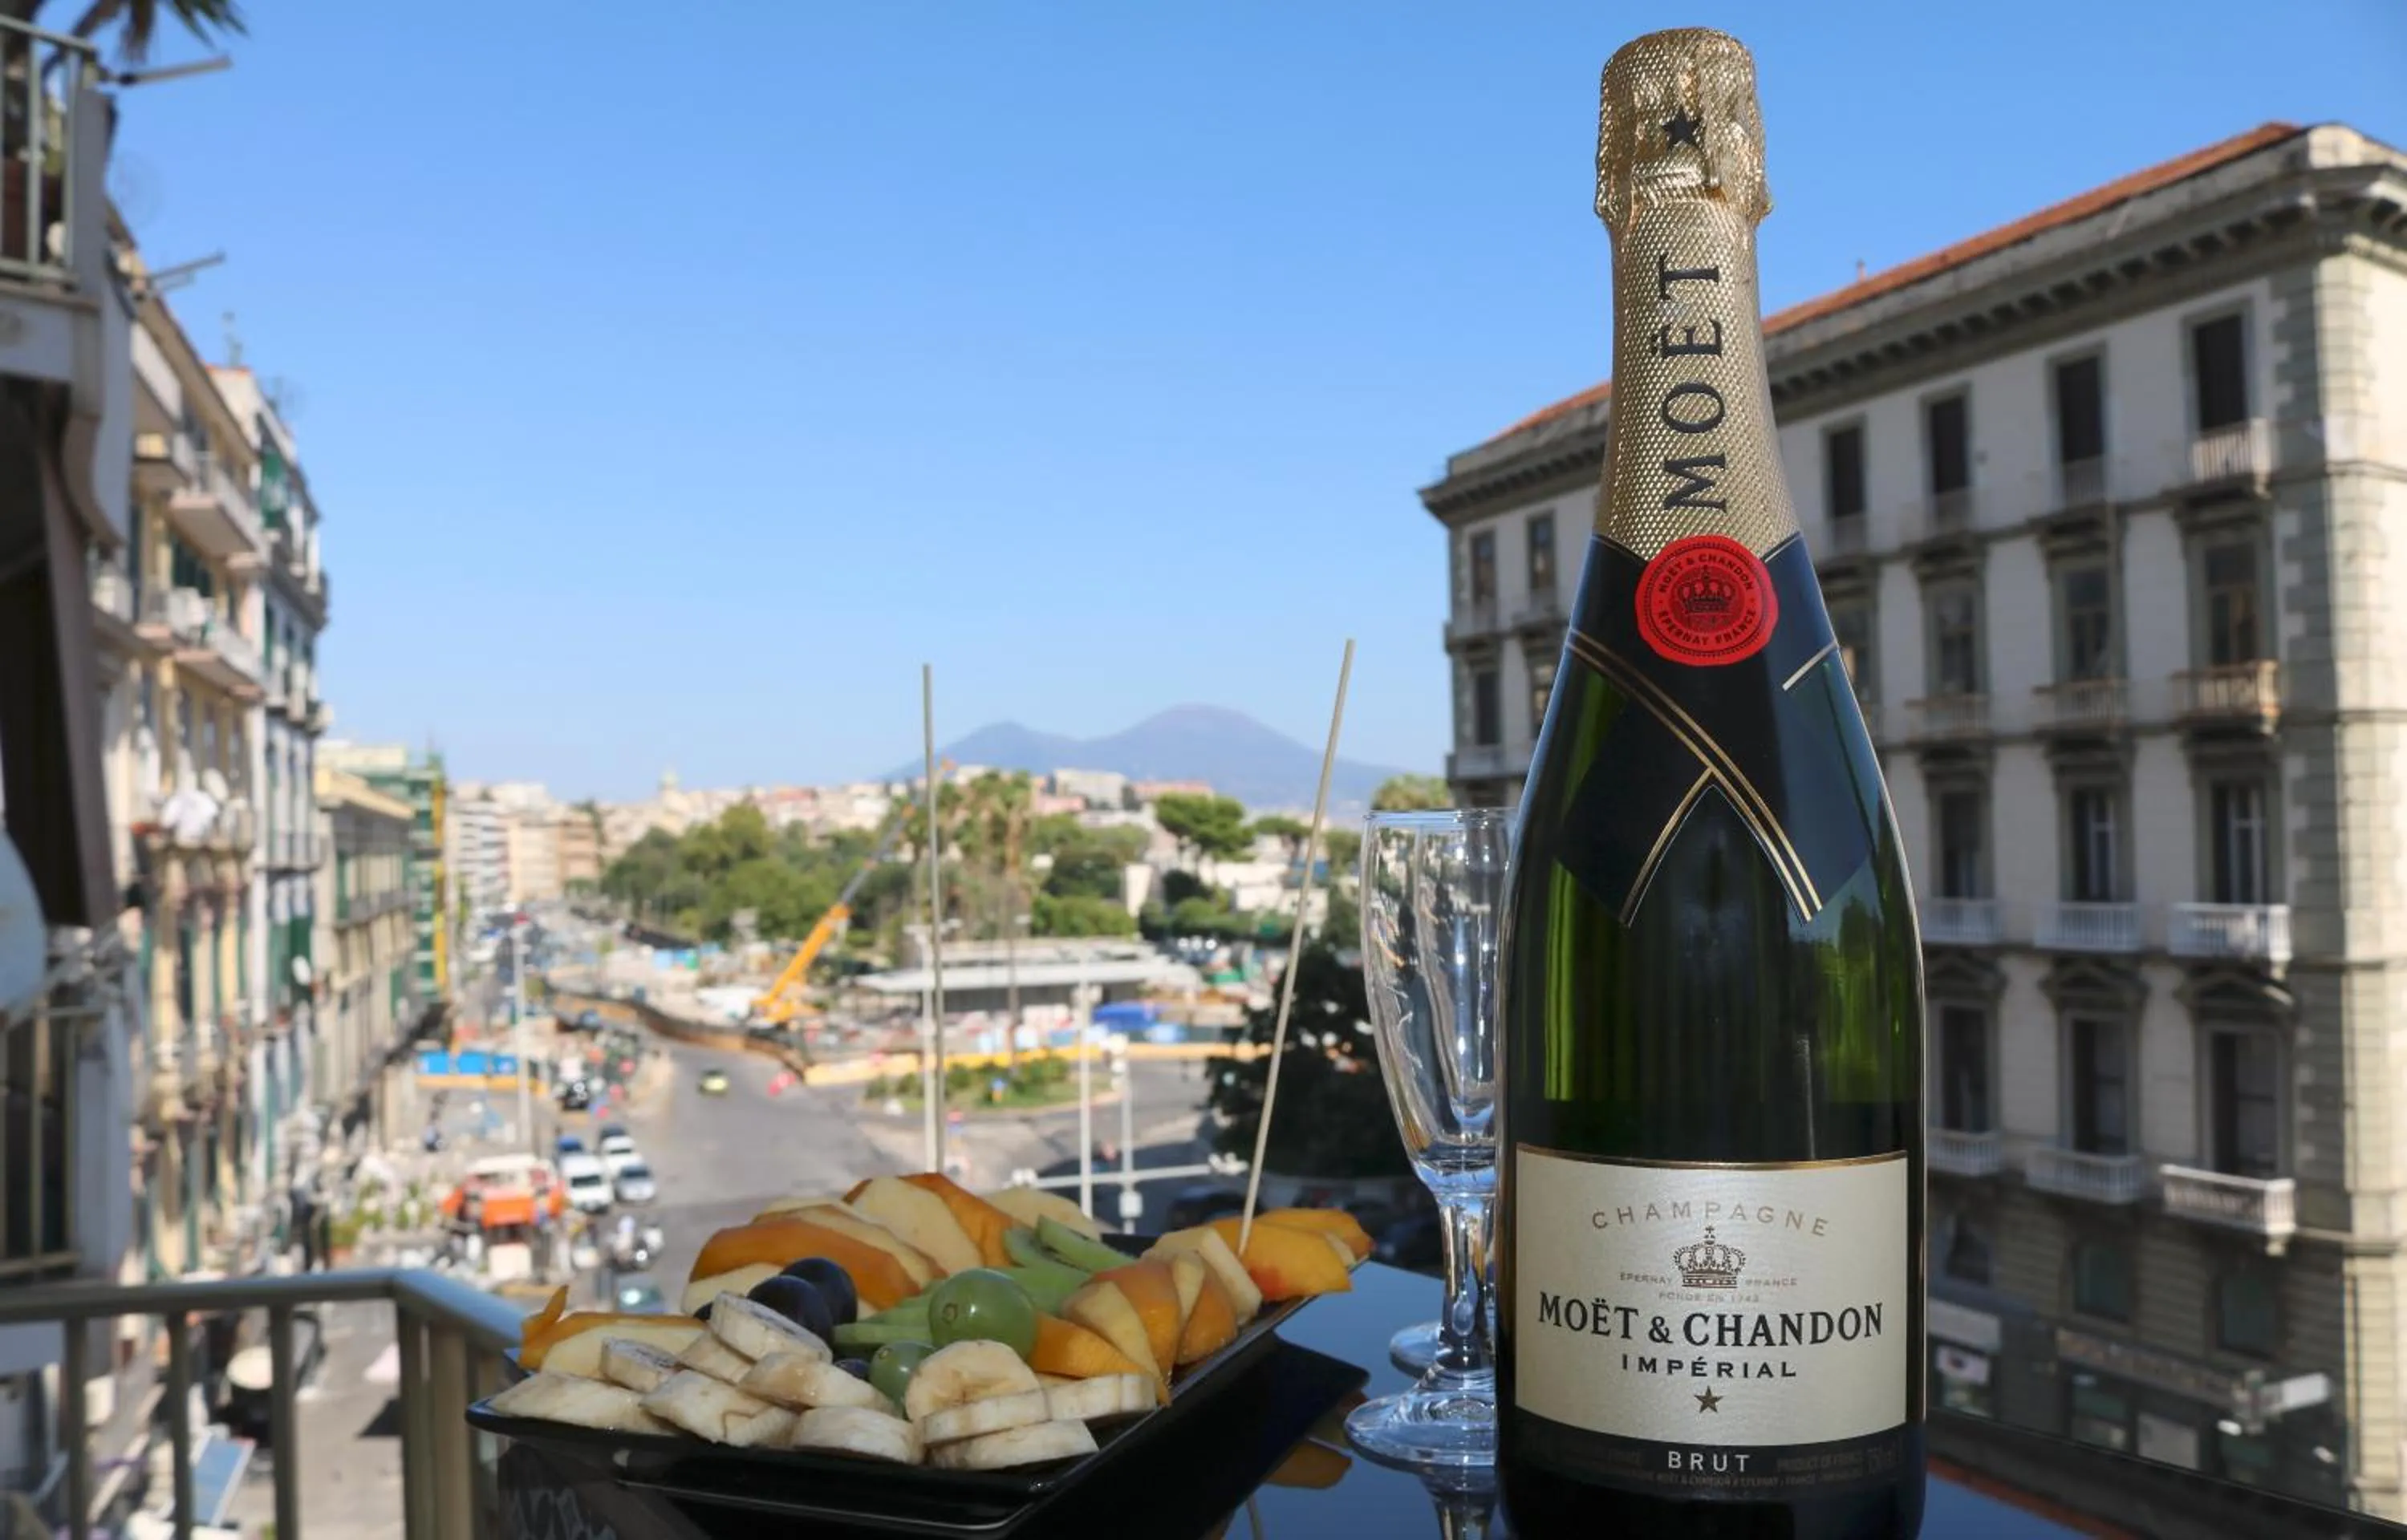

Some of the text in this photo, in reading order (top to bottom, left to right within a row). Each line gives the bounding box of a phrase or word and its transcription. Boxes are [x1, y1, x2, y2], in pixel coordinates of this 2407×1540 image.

[1651, 253, 1727, 513] MOËT
[1698, 553, 1755, 590] CHANDON
[1715, 608, 1756, 644] FRANCE
[1592, 1200, 1829, 1238] CHAMPAGNE
[1744, 1277, 1799, 1287] FRANCE
[1538, 1291, 1883, 1348] MOËT & CHANDON
[1621, 1352, 1797, 1379] IMPÉRIAL
[1667, 1450, 1751, 1473] BRUT
